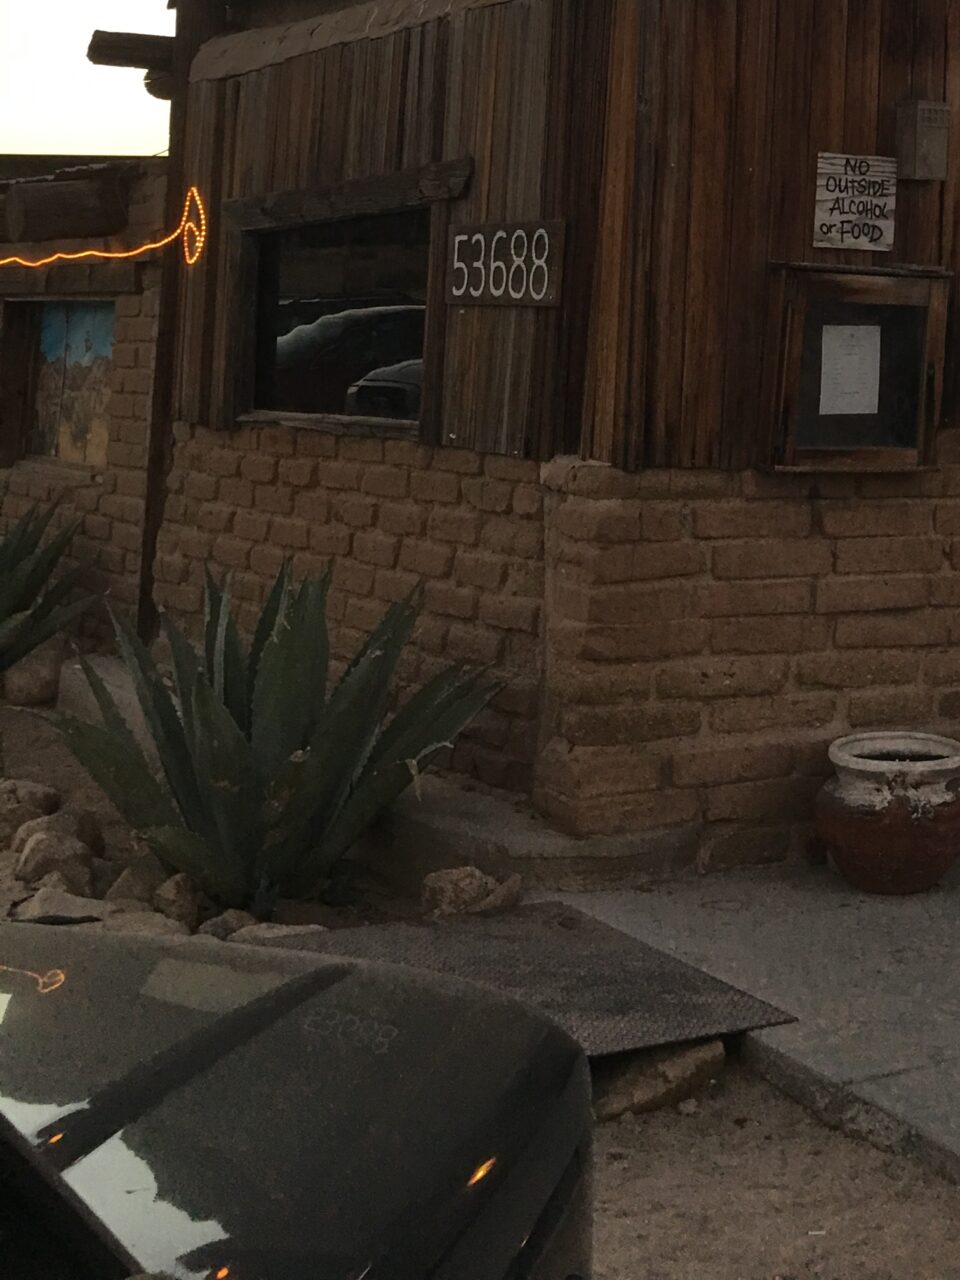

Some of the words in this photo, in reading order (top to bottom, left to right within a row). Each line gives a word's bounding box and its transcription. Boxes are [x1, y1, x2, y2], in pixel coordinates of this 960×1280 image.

[844, 158, 870, 175] NO
[826, 176, 891, 197] OUTSIDE
[829, 197, 889, 219] ALCOHOL
[840, 220, 883, 243] FOOD
[452, 228, 549, 300] 53688
